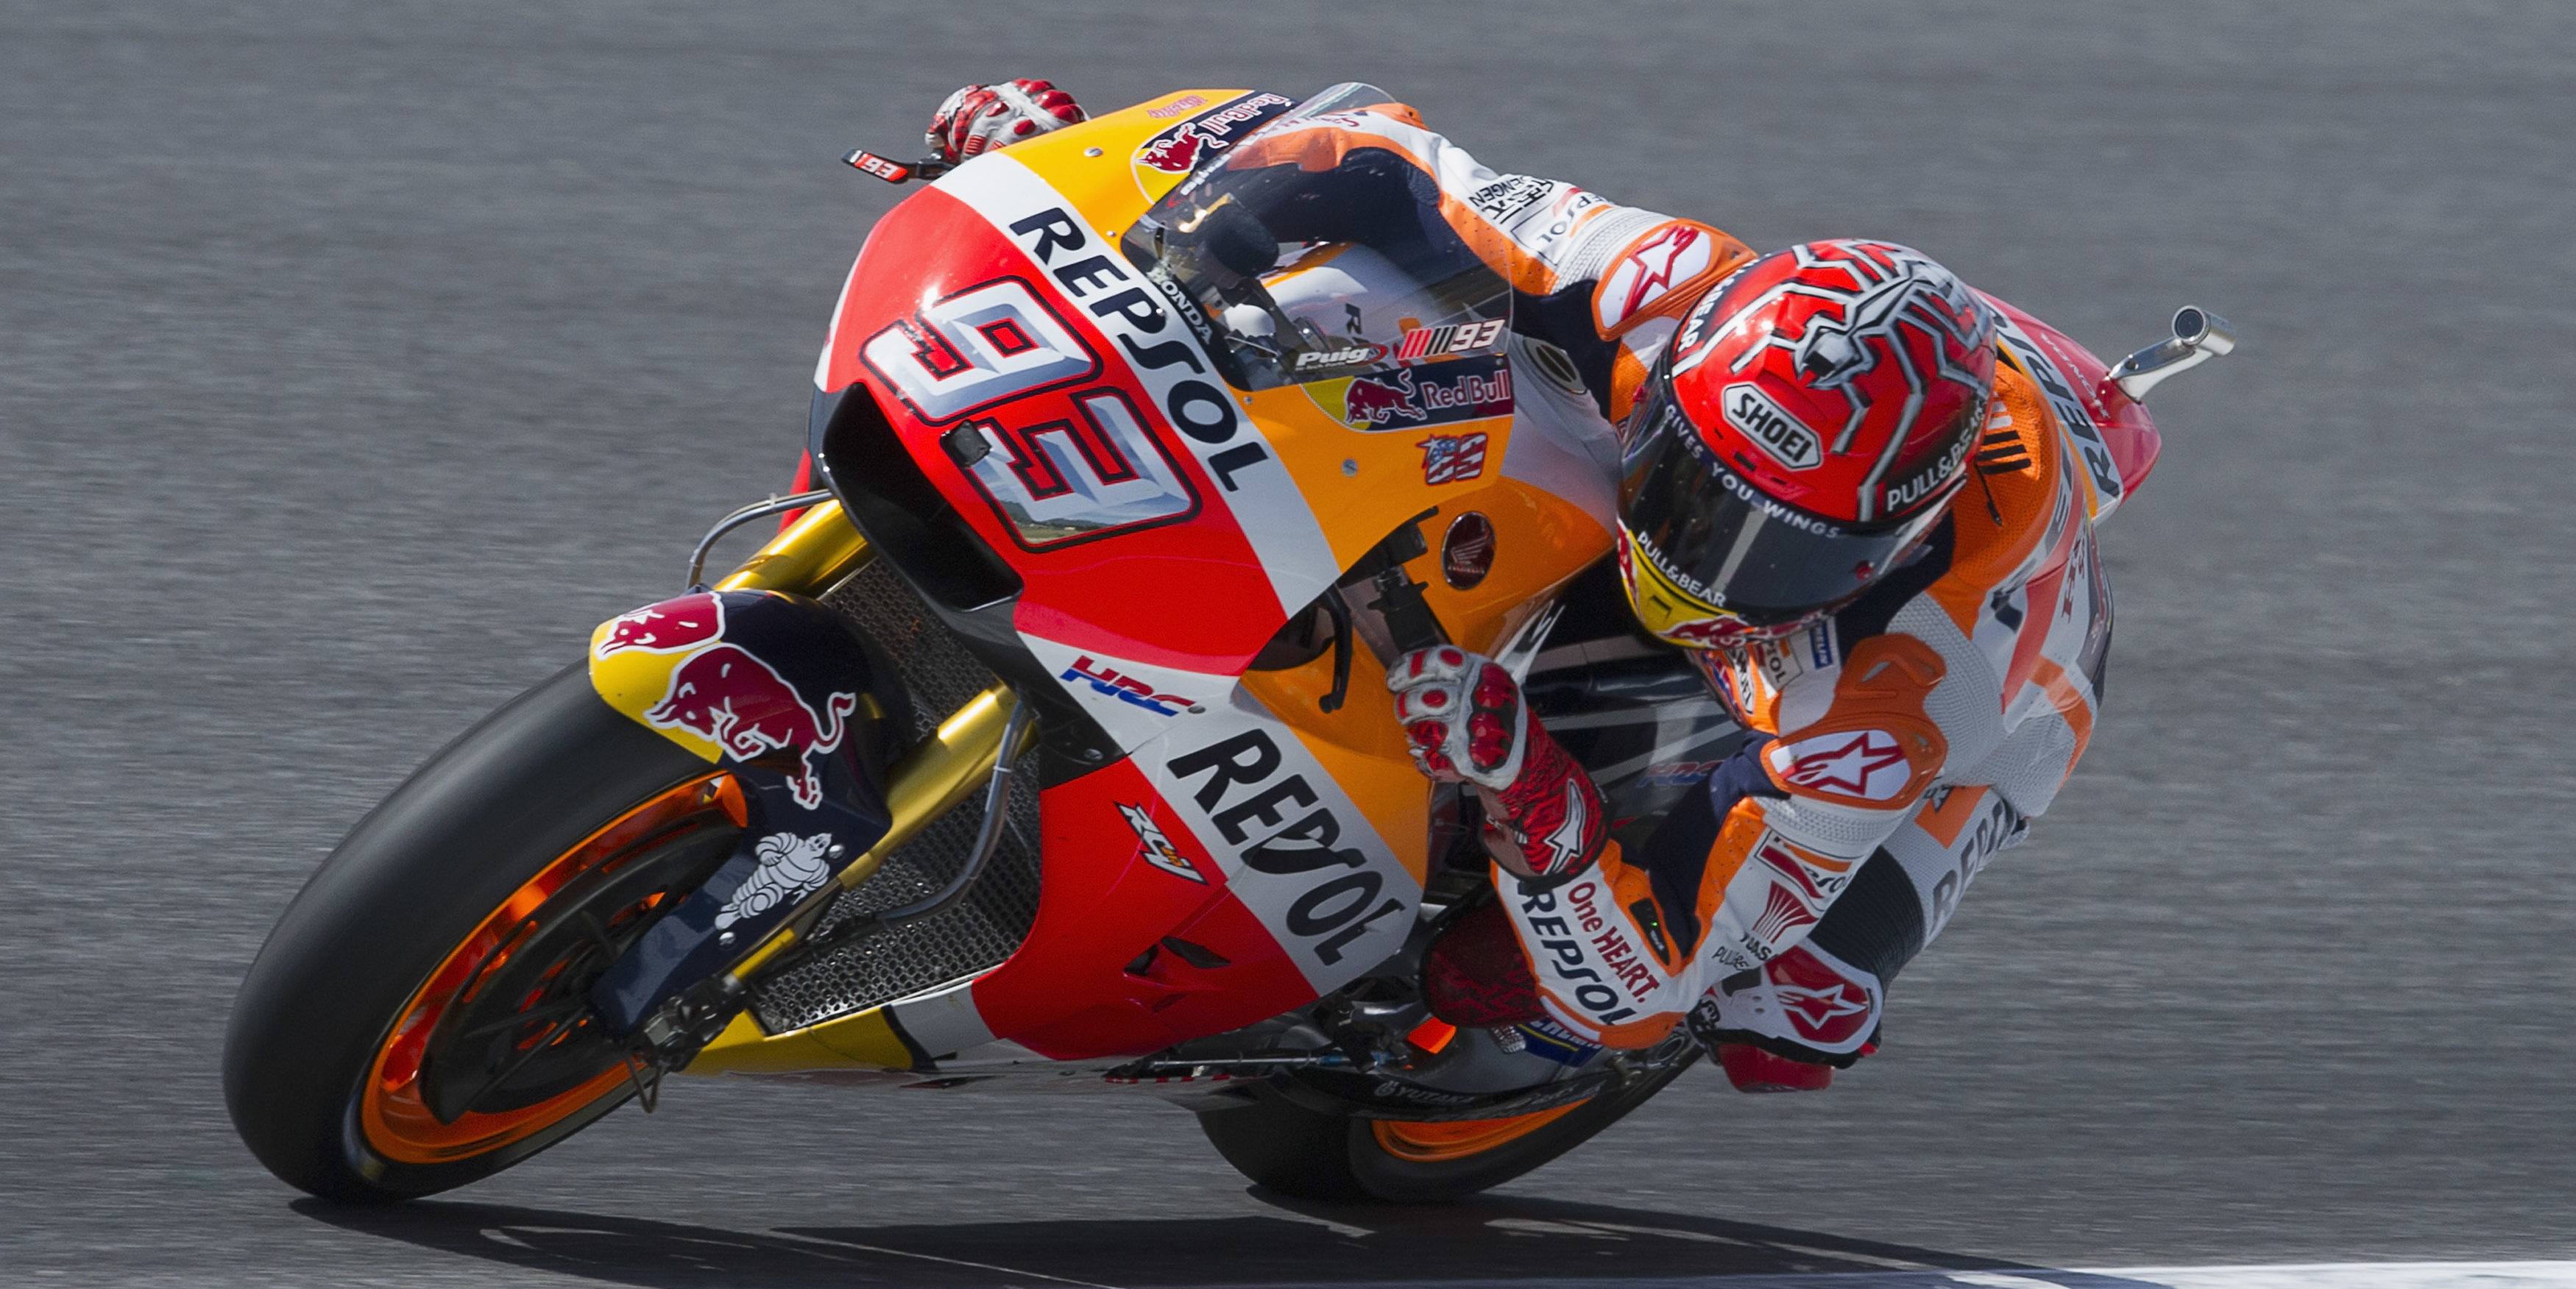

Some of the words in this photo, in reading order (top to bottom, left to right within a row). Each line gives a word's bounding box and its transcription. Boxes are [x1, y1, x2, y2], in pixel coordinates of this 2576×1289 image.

[1197, 110, 1253, 136] Bull
[1234, 93, 1289, 116] Red
[861, 157, 899, 179] 93
[1009, 207, 1269, 492] REPSOL
[1296, 347, 1370, 366] Puig
[1448, 319, 1505, 353] 93
[860, 276, 1203, 553] 93
[1420, 375, 1468, 410] Red
[1468, 369, 1510, 404] Bull
[1989, 308, 2120, 498] REPS
[1732, 393, 1813, 463] SHOEI
[1664, 404, 1704, 459] GIVES
[1711, 462, 1755, 501] YOU
[1763, 500, 1840, 539] WINGS
[1636, 530, 1727, 607] PULL&BEAR
[1059, 655, 1196, 717] HRC
[1166, 728, 1406, 967] REPSOL
[1517, 881, 1637, 1026] REPSOL
[1568, 881, 1603, 932] One
[1591, 926, 1660, 1004] HEART.
